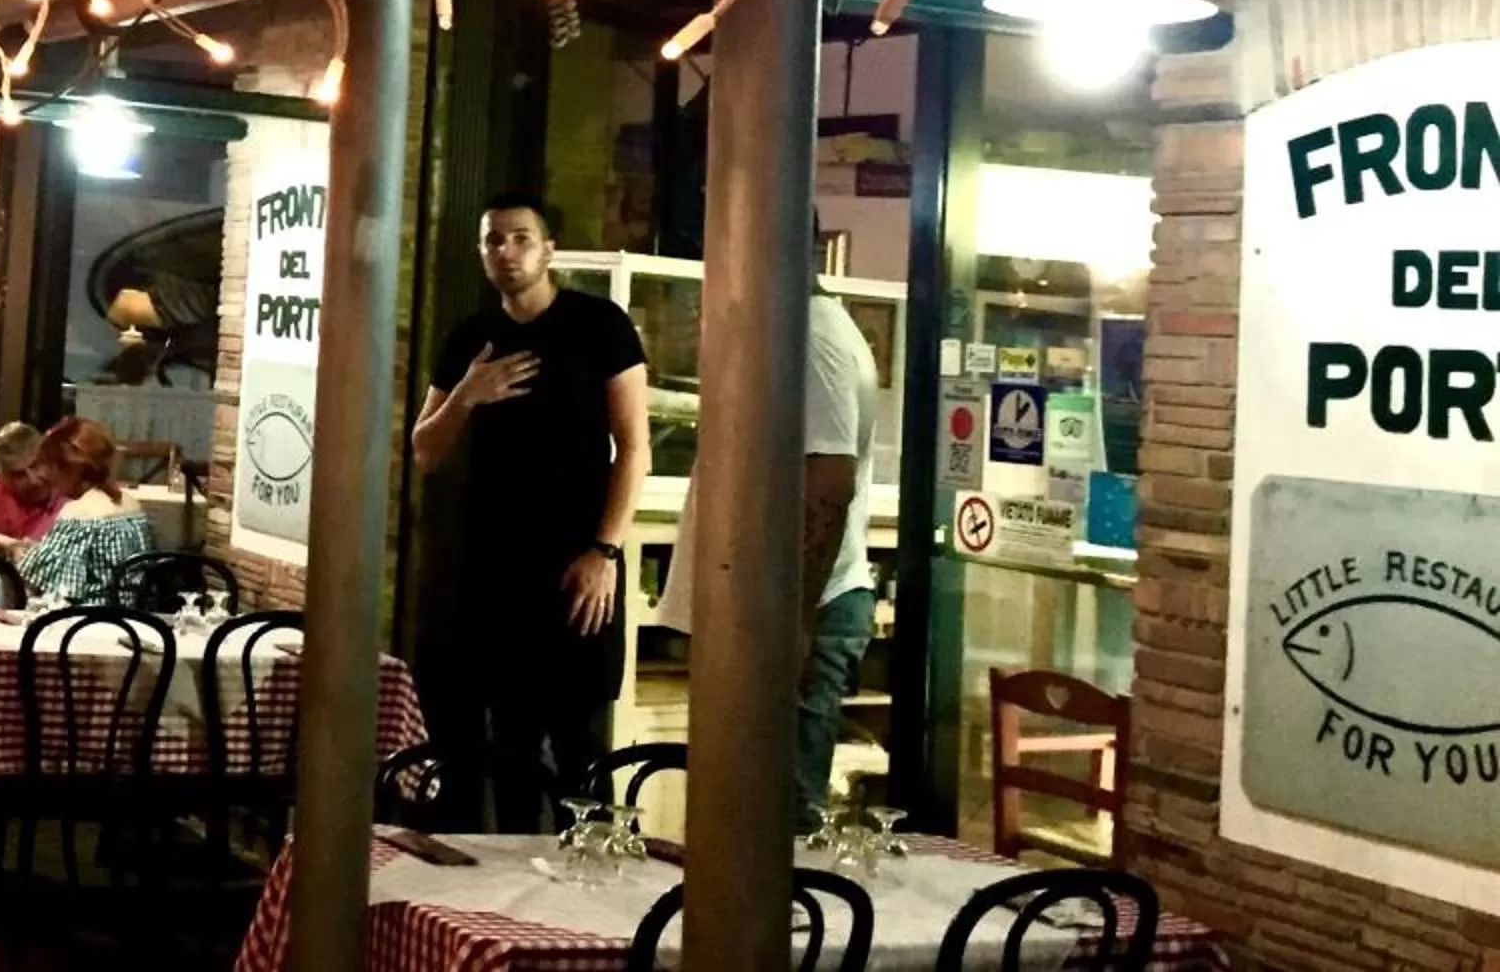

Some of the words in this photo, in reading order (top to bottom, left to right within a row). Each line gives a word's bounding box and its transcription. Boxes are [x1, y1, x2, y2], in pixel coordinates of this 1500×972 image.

[257, 184, 326, 240] FRONT
[280, 249, 310, 279] DEL
[256, 293, 320, 342] PORT
[1307, 341, 1500, 443] POR
[252, 474, 273, 506] FOR
[275, 480, 300, 506] YOU
[1270, 556, 1362, 627] LITTLE
[1315, 708, 1396, 777] FOR
[1415, 740, 1499, 785] YOU
